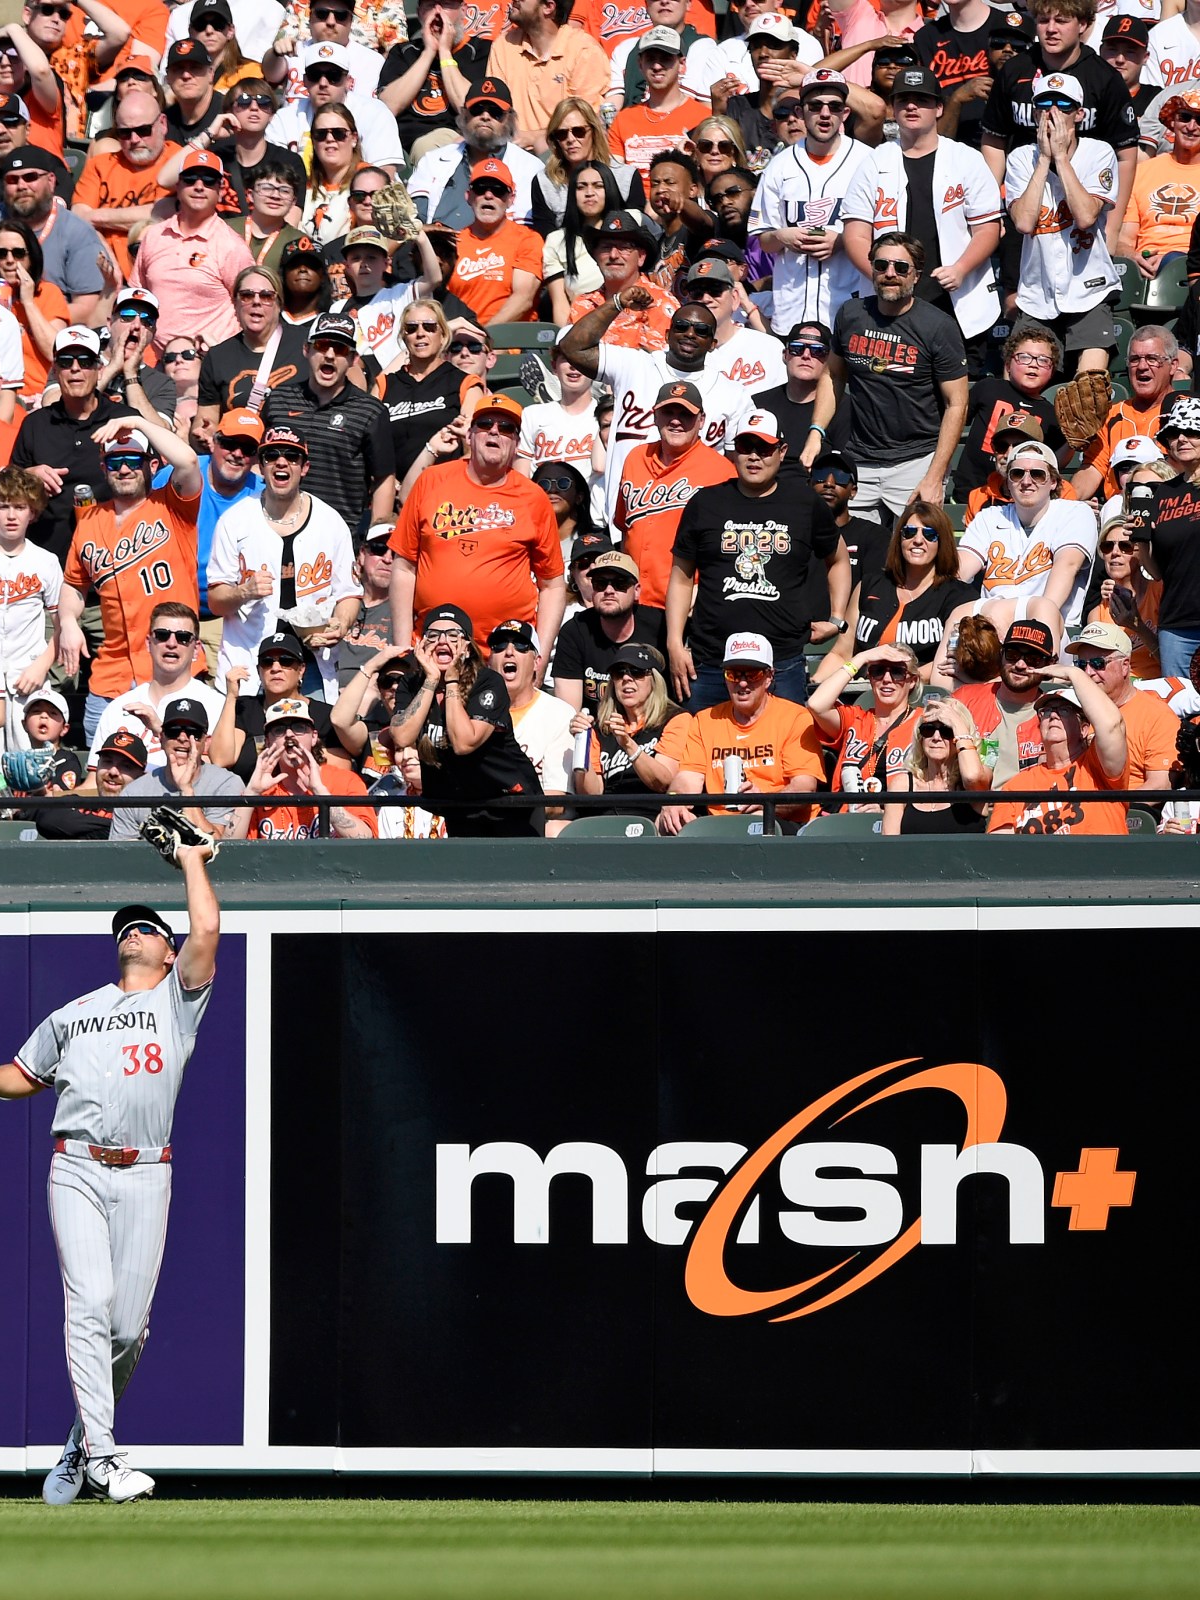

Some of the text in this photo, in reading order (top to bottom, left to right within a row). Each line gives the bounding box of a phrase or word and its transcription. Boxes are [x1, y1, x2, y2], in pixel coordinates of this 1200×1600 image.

[929, 49, 990, 79] Oriole
[1011, 100, 1097, 131] BALRE
[784, 196, 844, 230] USA
[456, 251, 505, 279] Orioles
[848, 335, 920, 365] ORIOLES
[864, 328, 904, 344] BALTIMORE
[619, 476, 702, 516] Oriole
[1157, 492, 1193, 510] I'M A
[433, 502, 513, 531] Orioles
[1156, 501, 1200, 524] HUGGE
[722, 518, 790, 537] Opening Day
[720, 531, 791, 555] 2026
[138, 560, 175, 595] 10
[721, 576, 782, 597] Preston
[1010, 625, 1047, 644] BALTIMORE
[711, 743, 776, 762] ORIOLES
[69, 1011, 158, 1041] INNESOTA
[120, 1041, 165, 1077] 38
